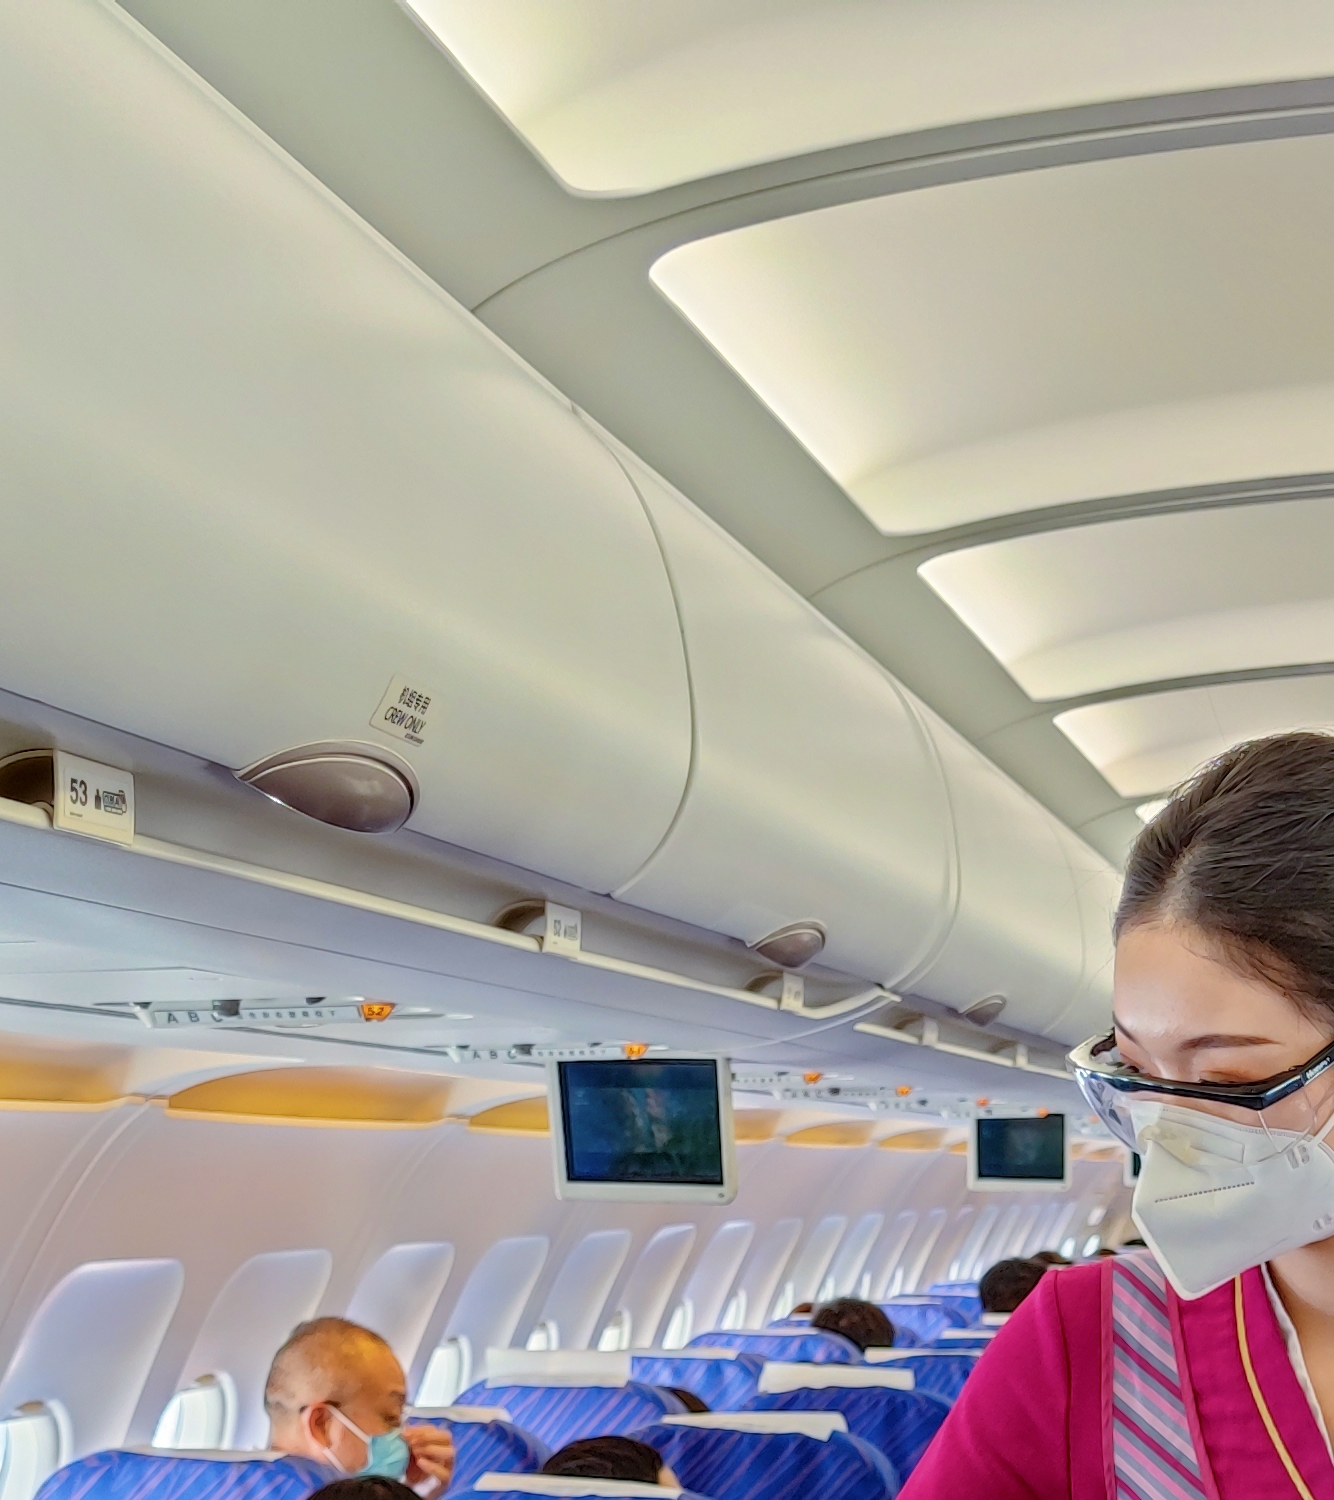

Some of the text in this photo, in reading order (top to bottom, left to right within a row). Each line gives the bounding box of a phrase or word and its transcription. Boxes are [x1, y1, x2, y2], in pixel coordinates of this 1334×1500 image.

[384, 706, 427, 734] CREW ONLY
[69, 777, 88, 807] 53
[168, 1012, 178, 1024] A
[188, 1011, 199, 1023] B
[367, 1007, 384, 1017] 52
